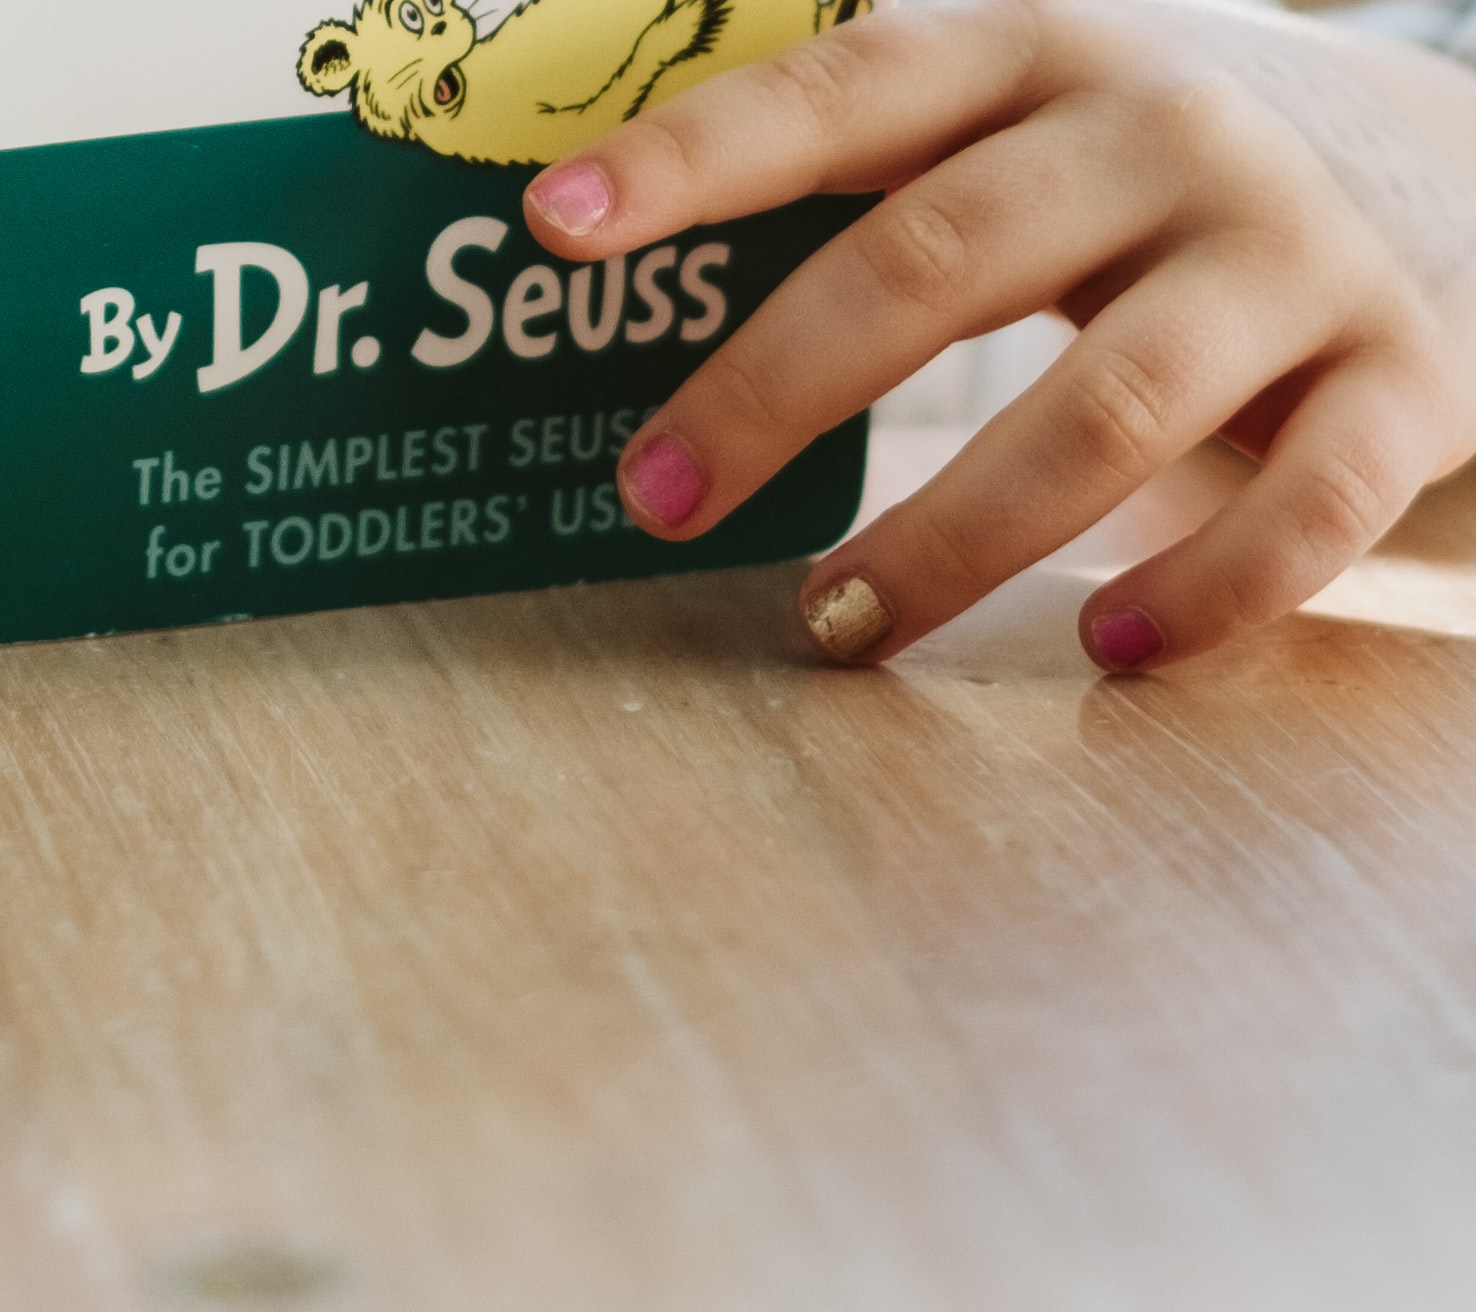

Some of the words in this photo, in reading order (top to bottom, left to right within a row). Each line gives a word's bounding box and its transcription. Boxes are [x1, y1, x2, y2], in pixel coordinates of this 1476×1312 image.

[79, 286, 182, 382] By
[194, 241, 381, 394] Dr.
[410, 216, 730, 368] Seuss
[132, 450, 223, 507] The
[243, 424, 489, 497] SIMPLEST
[508, 404, 659, 468] SEUS
[146, 524, 222, 580] for
[241, 495, 528, 569] TODDLERS'
